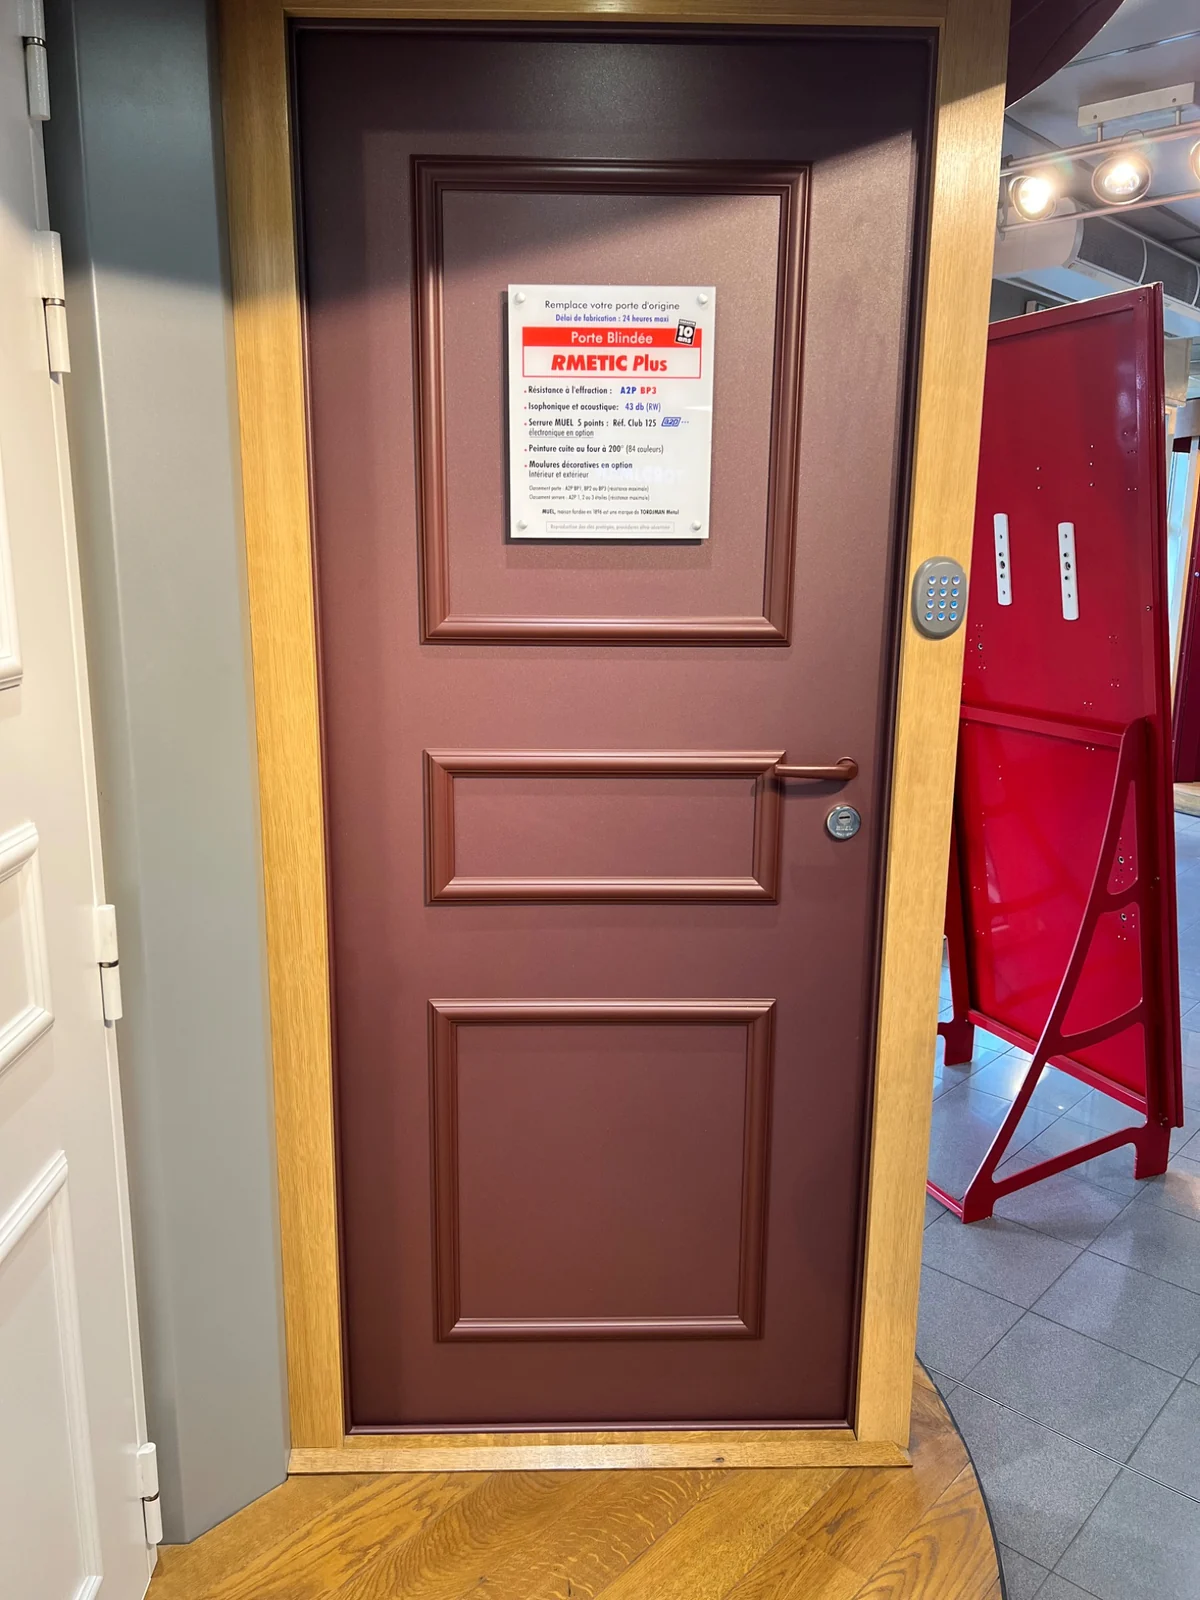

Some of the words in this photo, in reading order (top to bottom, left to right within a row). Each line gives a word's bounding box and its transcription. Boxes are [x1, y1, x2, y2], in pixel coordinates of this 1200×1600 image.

[545, 300, 588, 310] Remplace
[616, 303, 638, 312] porte
[642, 302, 680, 312] d'origine
[556, 314, 572, 322] Délai
[678, 325, 693, 338] 10
[572, 332, 603, 344] Porte
[607, 332, 653, 344] Blindée
[551, 354, 627, 371] RMETIC
[633, 354, 668, 372] Plus
[528, 386, 563, 394] Résistance
[572, 386, 607, 394] l'effraction
[528, 402, 570, 412] Isophonique
[580, 403, 619, 412] acoustique:
[646, 403, 661, 412] (RW)
[584, 419, 604, 428] points
[628, 419, 643, 427] Club
[529, 428, 564, 437] électronique
[575, 429, 594, 437] option
[626, 445, 636, 454] (84
[637, 445, 664, 454] couleurs)
[611, 461, 633, 470] option
[529, 470, 554, 478] Intérieur
